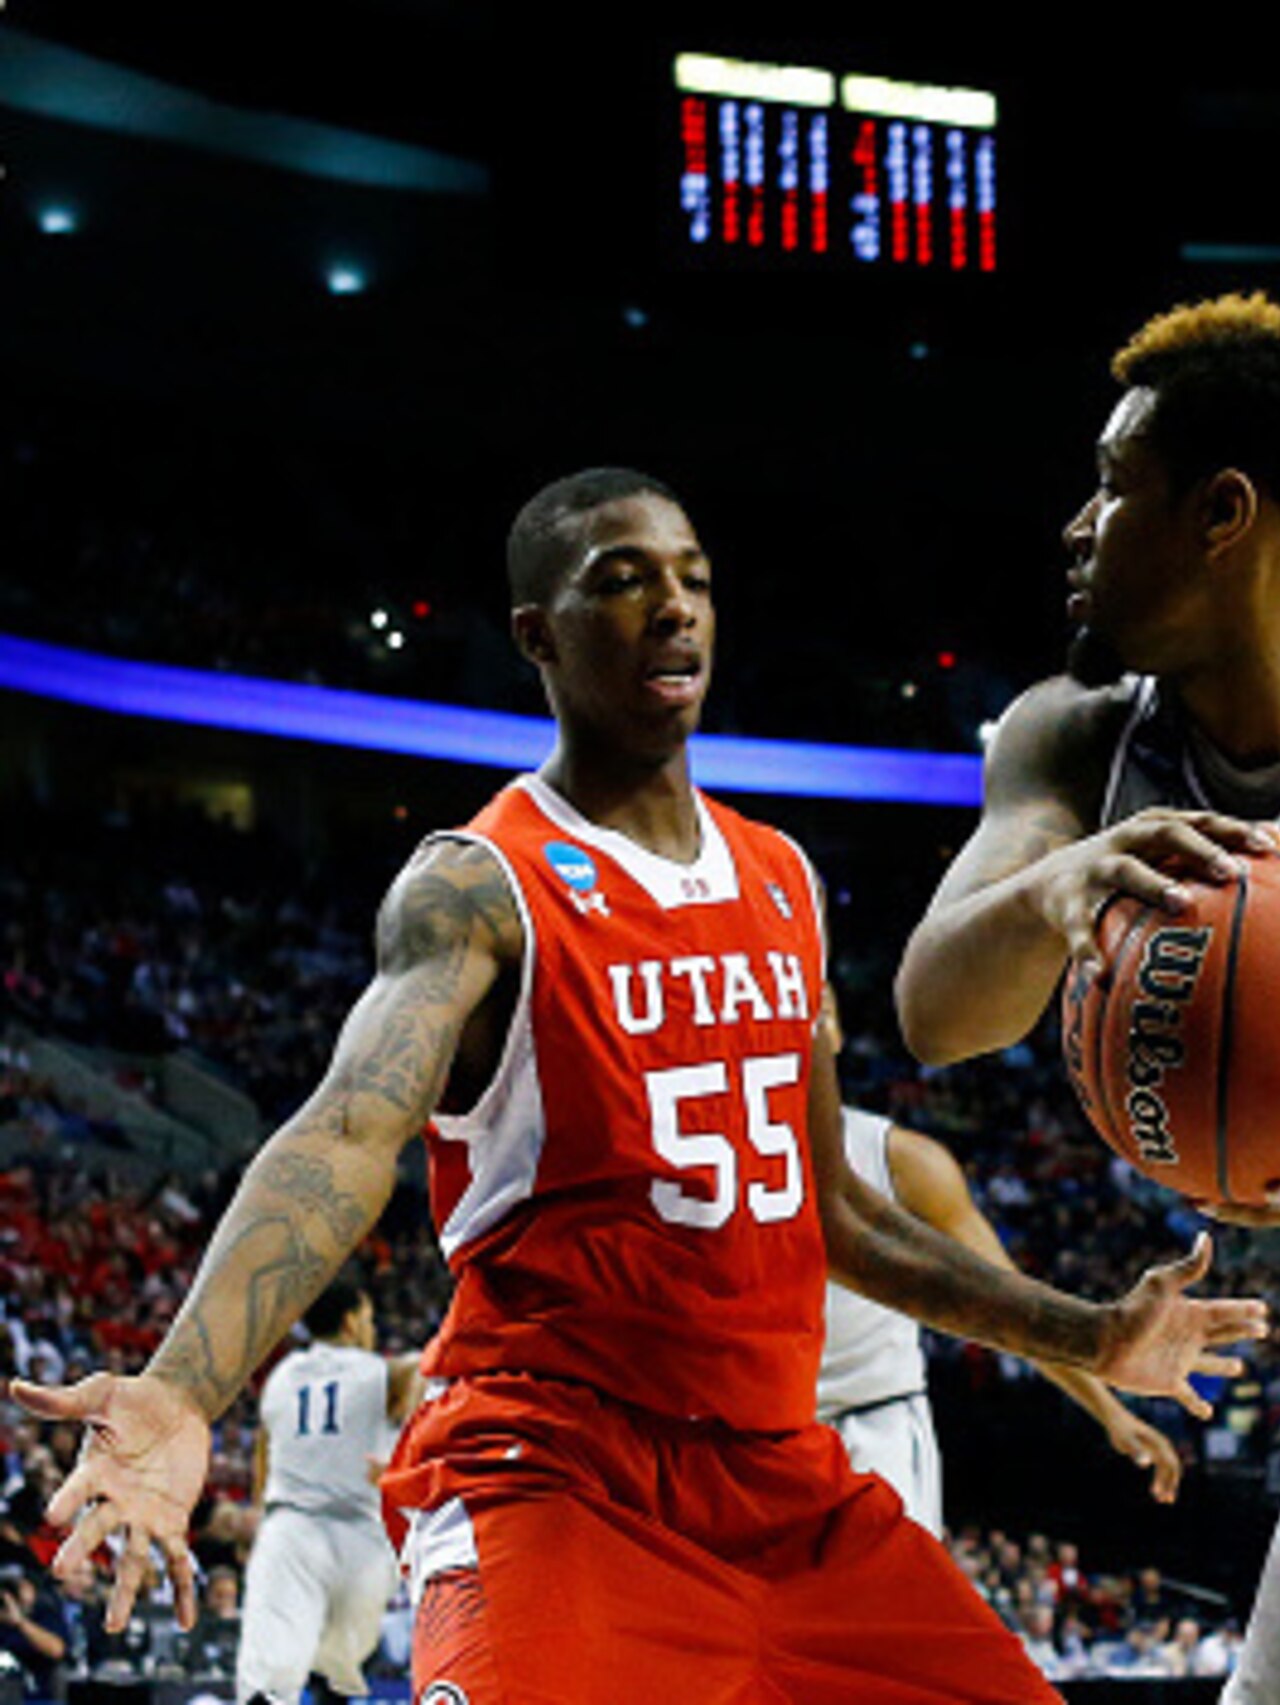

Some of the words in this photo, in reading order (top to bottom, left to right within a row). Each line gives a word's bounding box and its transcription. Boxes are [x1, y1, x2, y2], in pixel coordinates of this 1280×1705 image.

[608, 951, 810, 1035] UTAH
[1125, 926, 1213, 1165] Wilson
[644, 1053, 804, 1230] 55
[296, 1379, 340, 1437] 11
